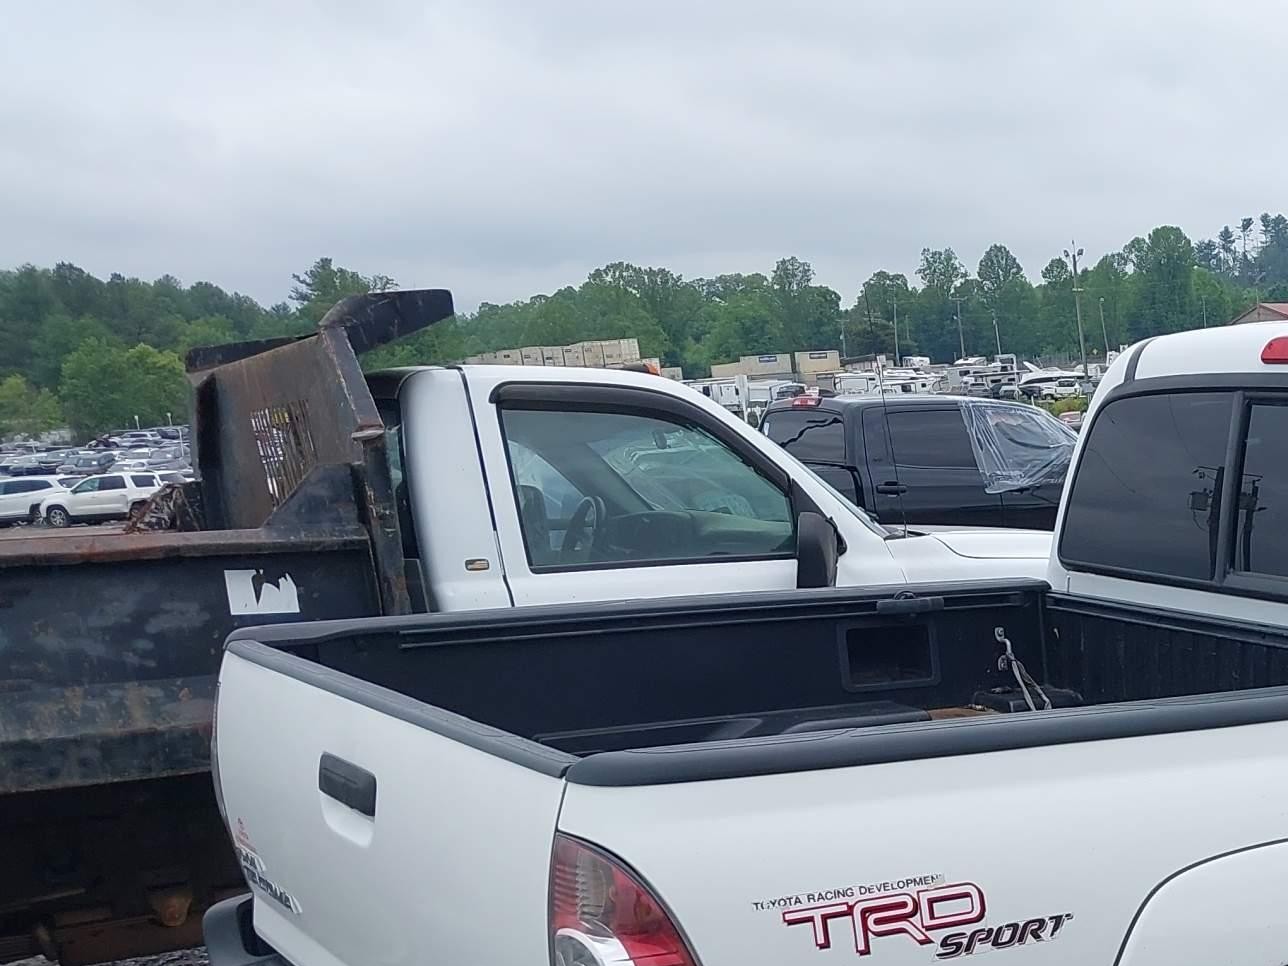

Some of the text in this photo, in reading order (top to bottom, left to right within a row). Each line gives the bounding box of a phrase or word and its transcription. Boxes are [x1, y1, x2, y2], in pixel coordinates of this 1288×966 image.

[807, 886, 855, 903] RACING
[858, 873, 942, 896] DEVELOPMEN
[782, 882, 986, 956] TRD
[935, 912, 1074, 960] SPORT
